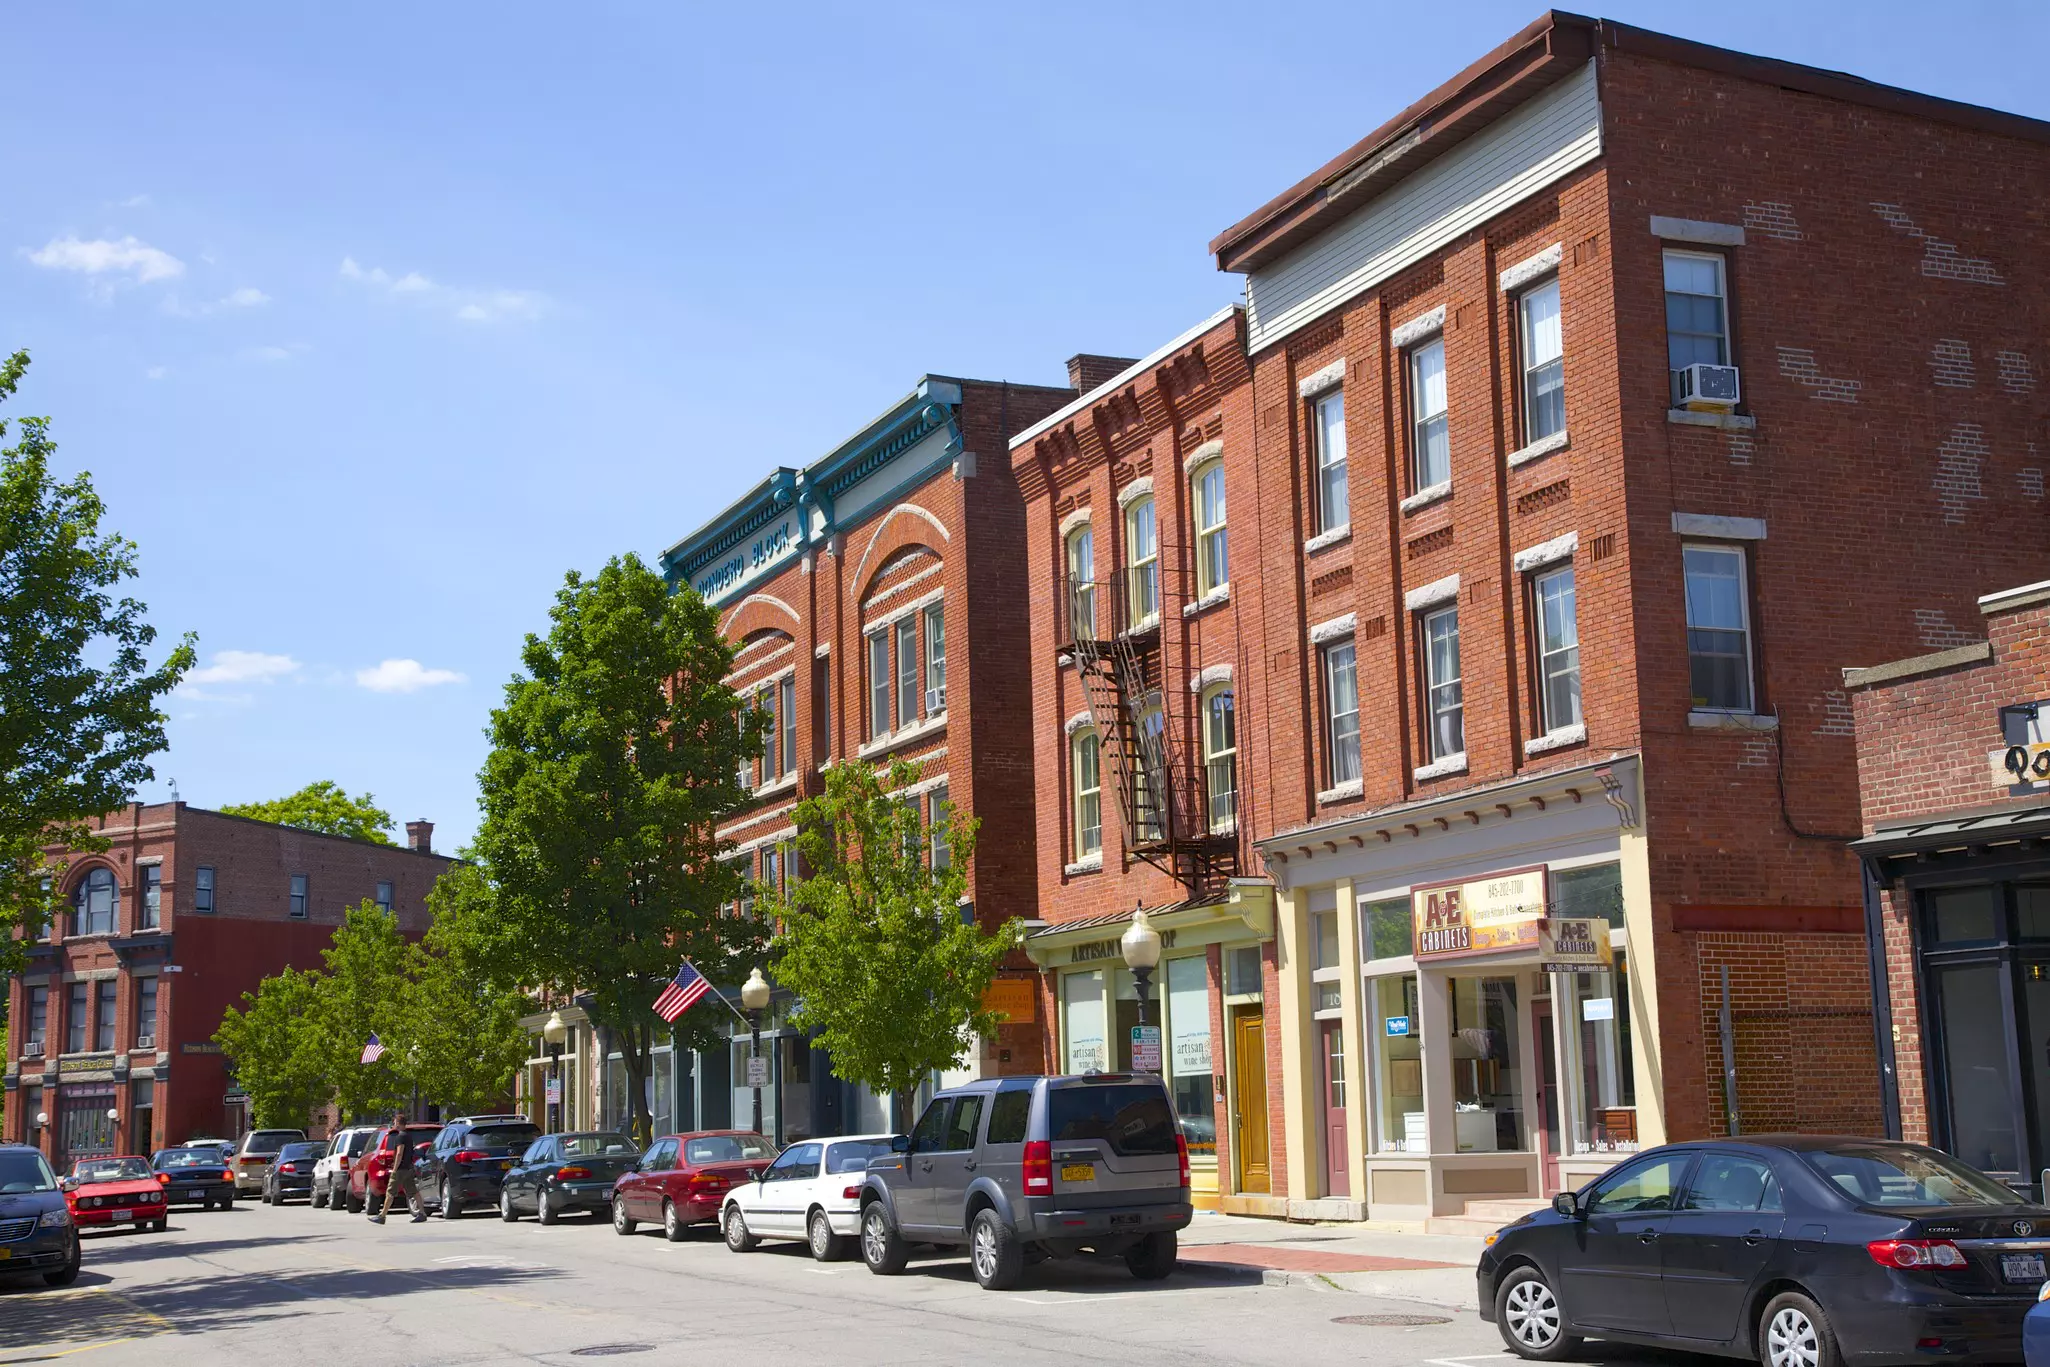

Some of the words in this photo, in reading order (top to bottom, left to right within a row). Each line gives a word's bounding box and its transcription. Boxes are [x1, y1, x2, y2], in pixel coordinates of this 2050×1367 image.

[698, 555, 744, 599] DONDERO
[752, 522, 790, 567] BLOCK
[1422, 927, 1468, 952] CABINETS
[1558, 941, 1594, 952] CABINETS
[1072, 940, 1114, 962] ARTISAN
[1072, 1044, 1096, 1058] artisan
[1176, 1040, 1204, 1054] artisan
[1078, 1060, 1090, 1068] wine
[1184, 1056, 1198, 1066] wine
[1596, 1139, 1608, 1152] Sales
